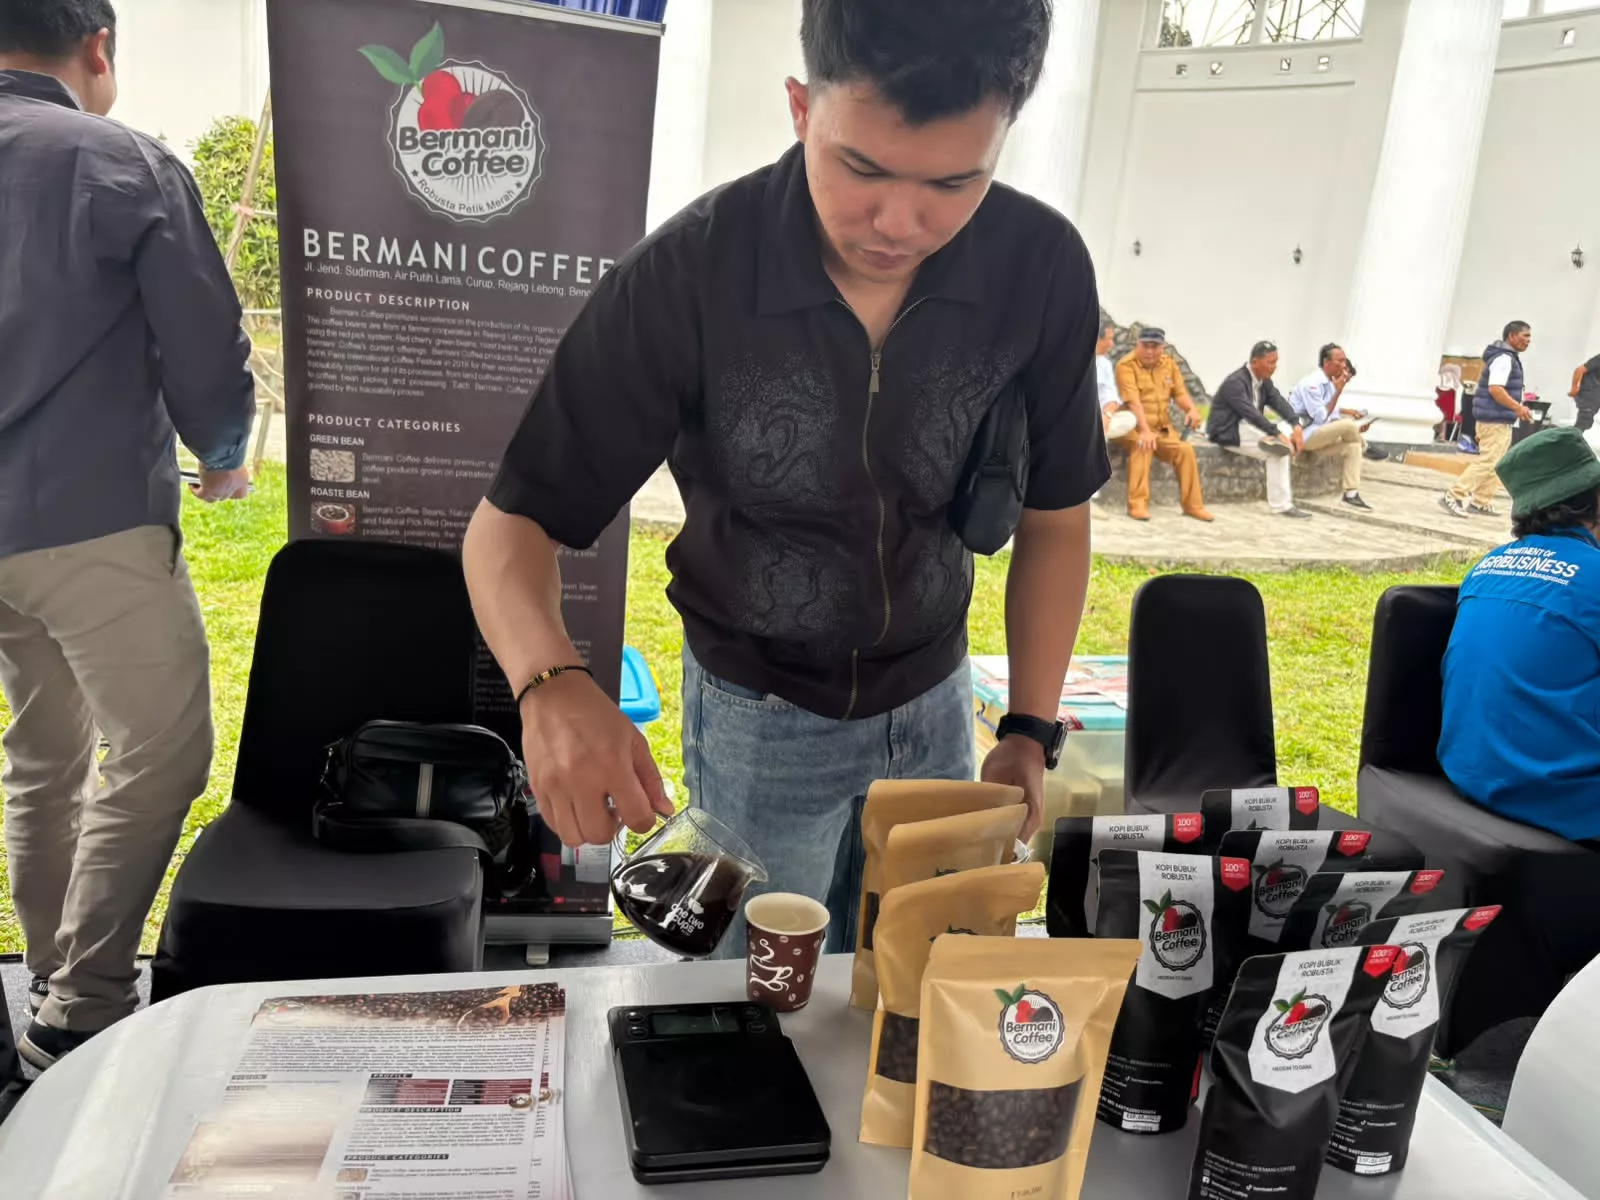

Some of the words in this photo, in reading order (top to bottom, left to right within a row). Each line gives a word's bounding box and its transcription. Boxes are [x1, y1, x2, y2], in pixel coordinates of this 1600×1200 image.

[399, 122, 532, 151] Bermani
[421, 151, 528, 178] Coffee
[418, 180, 456, 211] Robusta
[459, 203, 485, 214] Petik
[303, 229, 467, 271] BERMANI
[394, 271, 407, 282] Air
[410, 273, 434, 286] Putih
[498, 280, 529, 297] Rejang
[306, 288, 371, 303] PRODUCT
[379, 293, 471, 312] DESCRIPTION
[308, 414, 371, 427] PRODUCT
[377, 418, 461, 433] CATEGORIES
[309, 434, 338, 445] GREEN
[340, 436, 365, 446] BEAN
[310, 487, 345, 498] ROASTE
[346, 488, 370, 499] BEAN
[1475, 555, 1580, 578] AGRIBUSINESS
[1527, 571, 1570, 586] Management
[1109, 825, 1125, 833] KOPI
[1126, 824, 1150, 832] BUBUK
[1155, 864, 1172, 872] KOPI
[1173, 865, 1197, 873] BUBUK
[1161, 872, 1194, 881] ROBUSTA
[672, 914, 695, 933] cups
[688, 914, 704, 929] two
[1155, 927, 1200, 941] Bermani
[1162, 937, 1198, 951] Coffee
[1299, 960, 1316, 969] KOPI
[1317, 958, 1342, 967] BUBUK
[1300, 967, 1334, 976] ROBUSTA
[1391, 962, 1425, 981] ermani
[1389, 973, 1423, 992] Coffee
[1006, 1019, 1058, 1032] Bermani
[1013, 1032, 1054, 1044] Coffee
